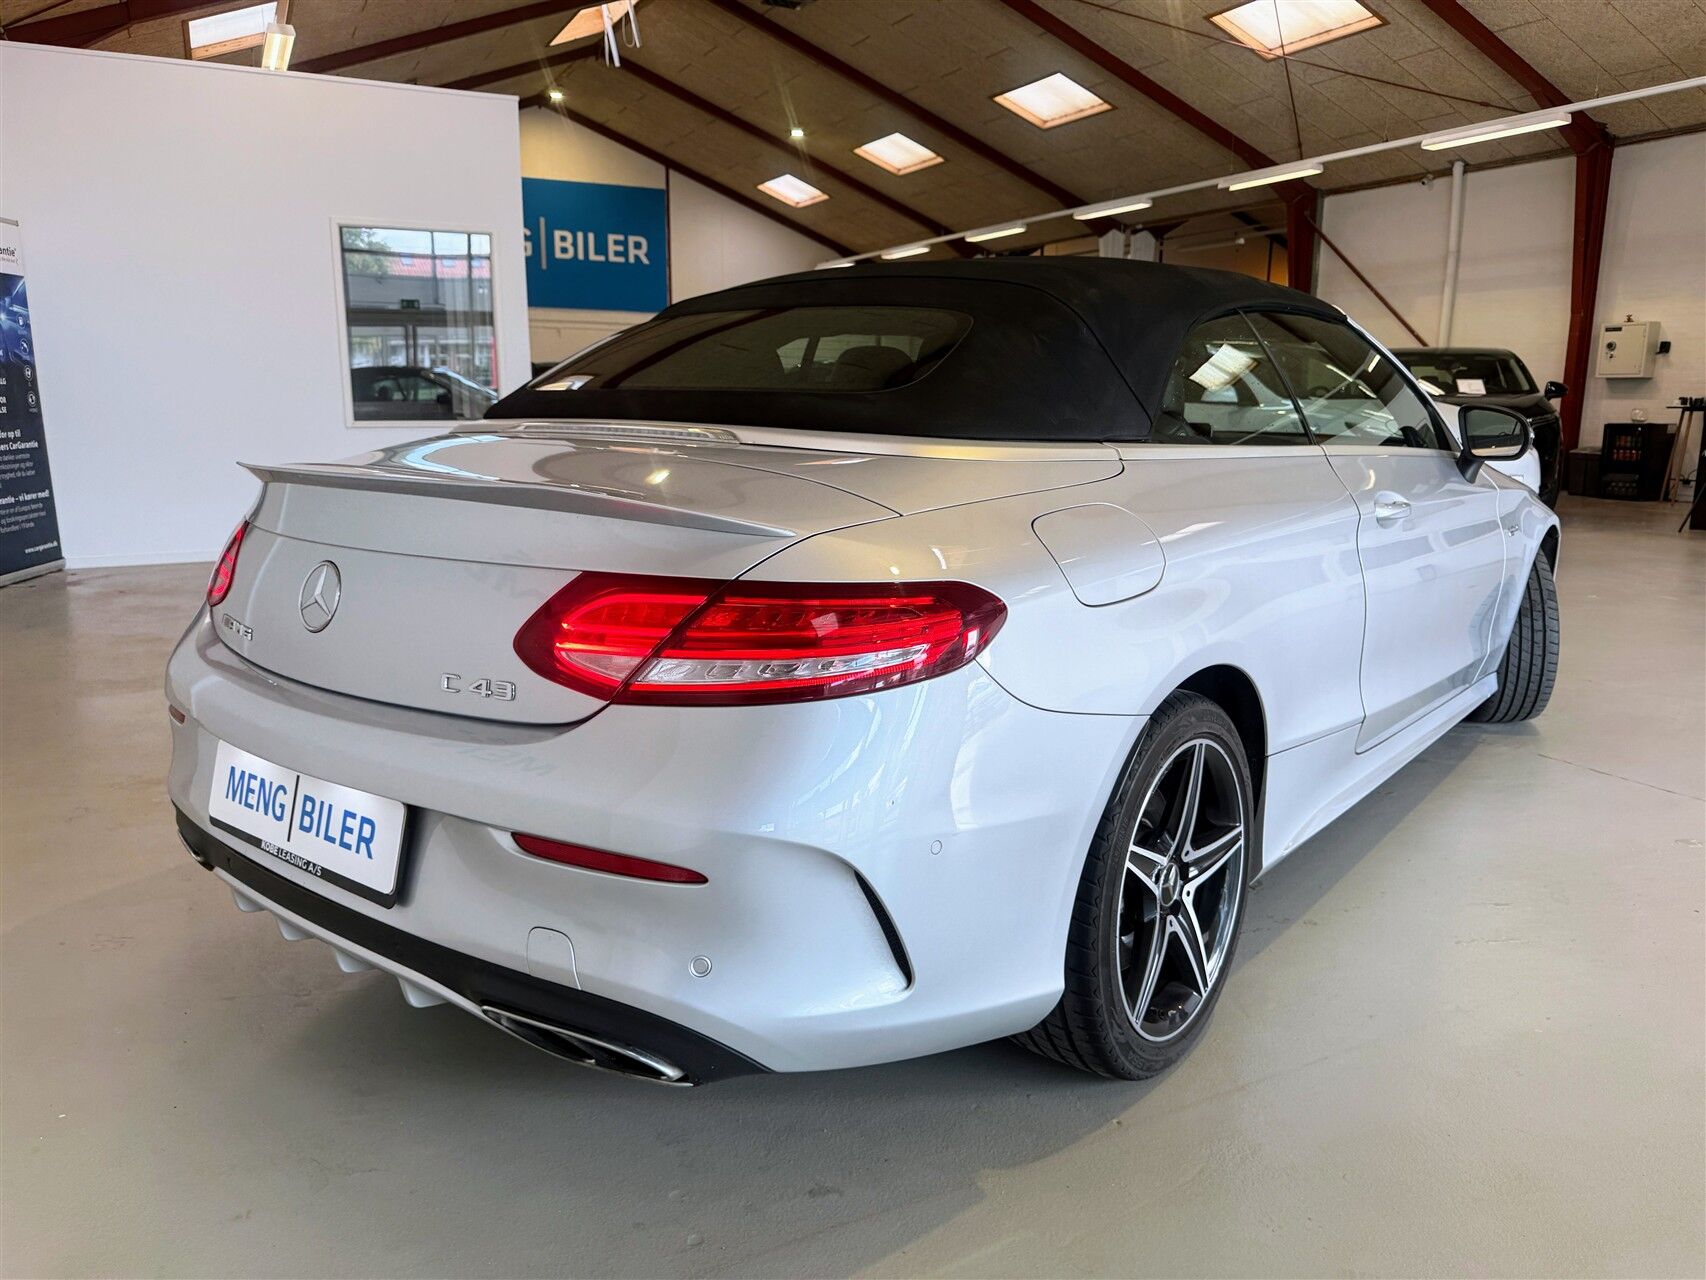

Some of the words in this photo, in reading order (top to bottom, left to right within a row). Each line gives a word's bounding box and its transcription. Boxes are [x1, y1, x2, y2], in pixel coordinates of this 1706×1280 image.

[553, 229, 650, 265] BILER
[9, 441, 38, 450] CarGarantie
[440, 672, 461, 693] C
[468, 678, 517, 702] 43
[225, 766, 288, 823] MENG
[298, 793, 376, 860] BILER
[279, 848, 308, 870] LEASING
[307, 861, 323, 877] A/S
